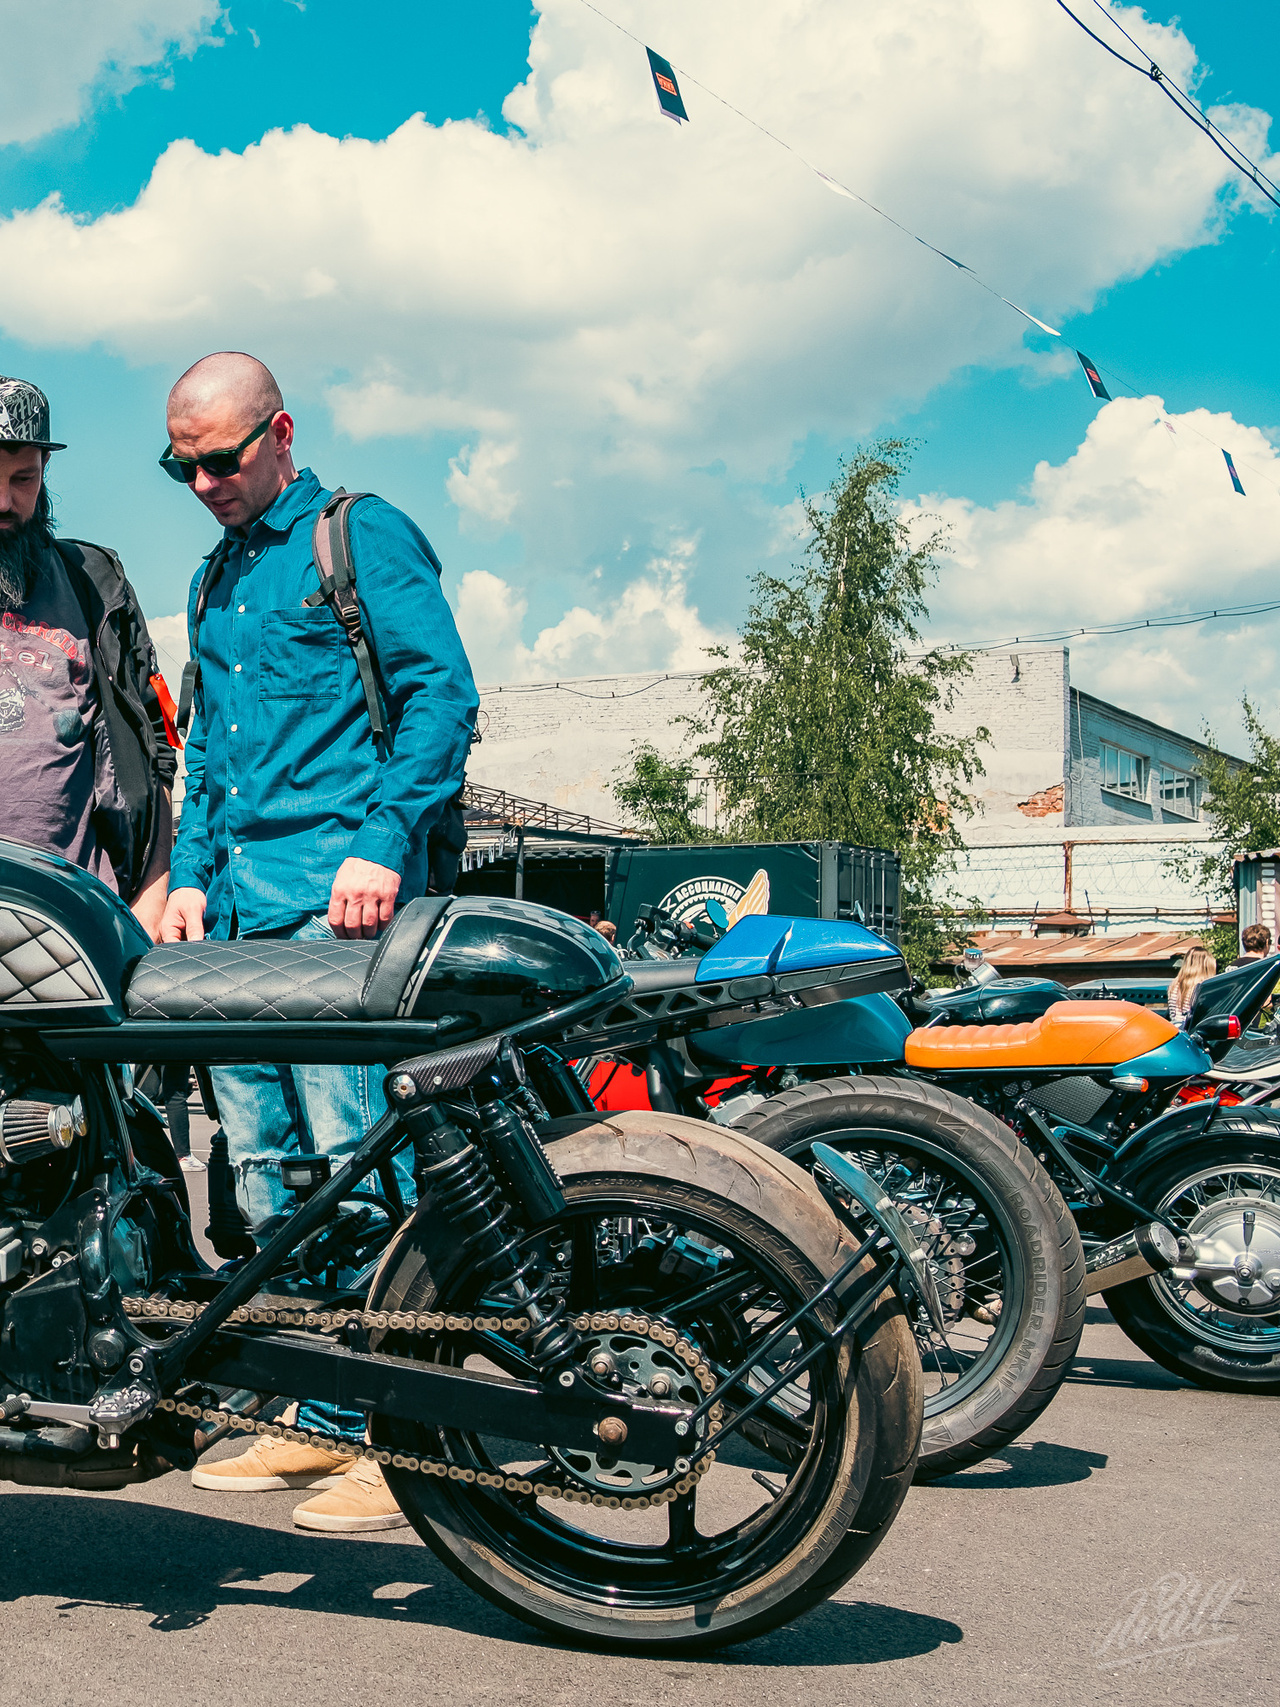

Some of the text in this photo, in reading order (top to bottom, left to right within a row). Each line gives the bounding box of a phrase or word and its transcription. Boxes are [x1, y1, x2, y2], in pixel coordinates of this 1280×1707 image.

[674, 880, 742, 902] АССОЦИАЦИЯ
[826, 1102, 928, 1127] AVON
[1010, 1190, 1048, 1332] ROADRIDER
